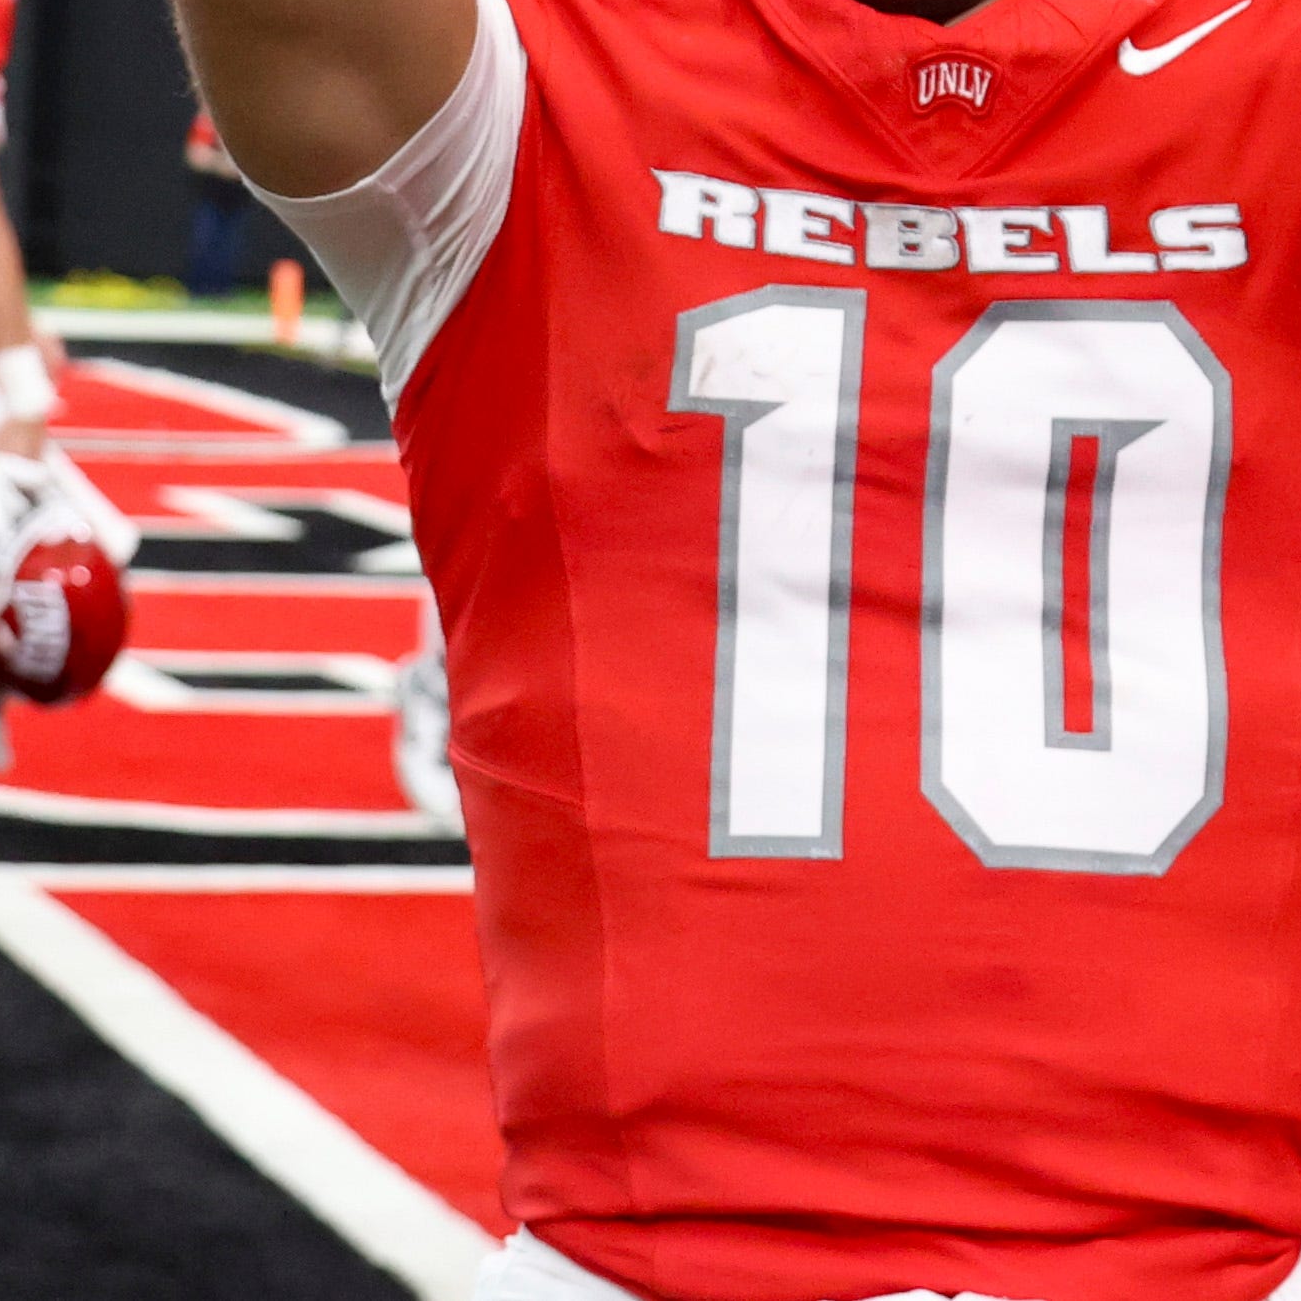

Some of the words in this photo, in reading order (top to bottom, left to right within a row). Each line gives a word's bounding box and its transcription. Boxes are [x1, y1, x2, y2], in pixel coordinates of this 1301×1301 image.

[918, 61, 992, 108] UNLV
[650, 167, 1249, 274] REBELS
[666, 283, 1233, 876] 10
